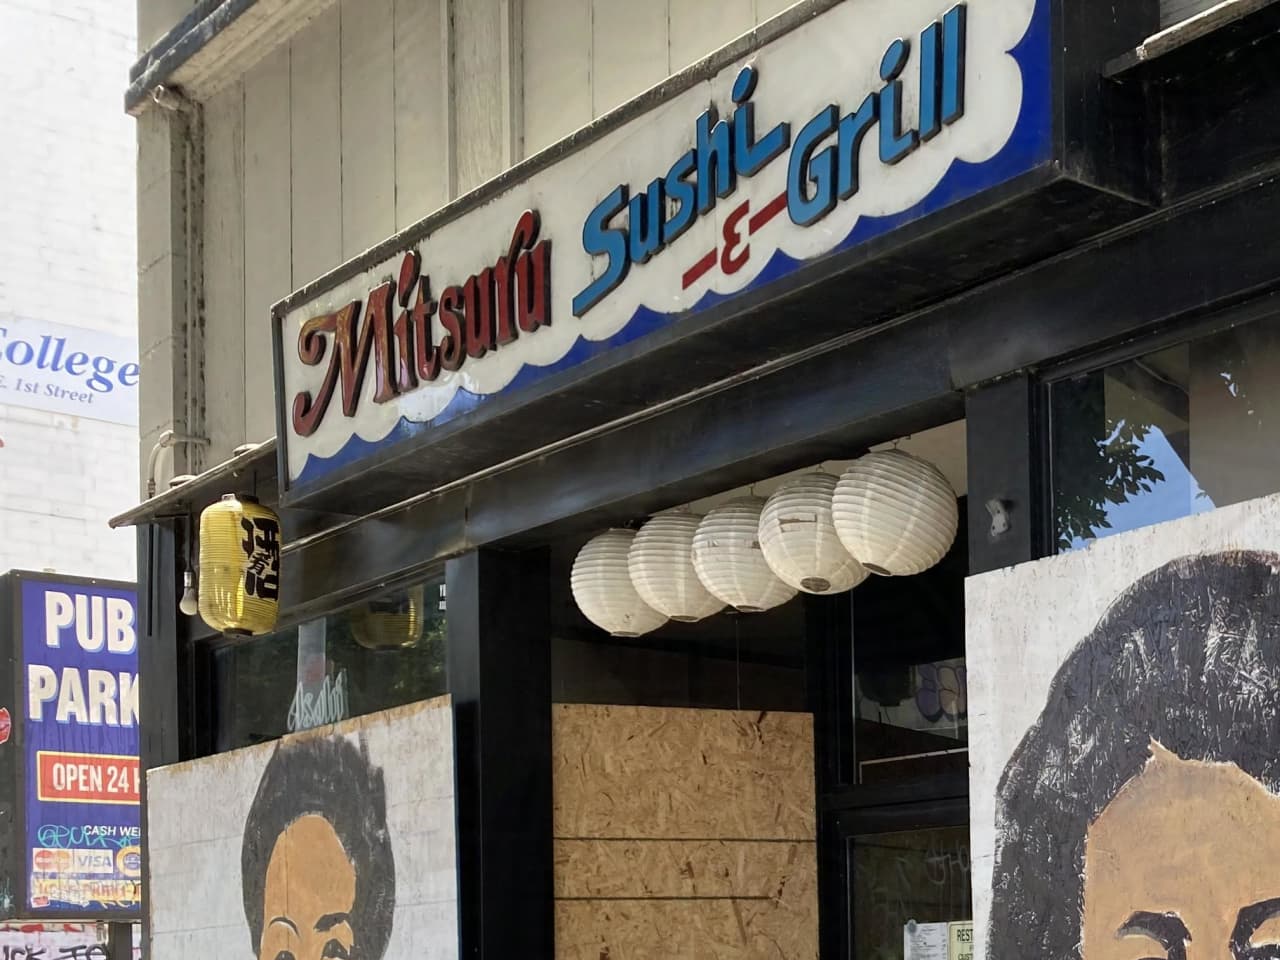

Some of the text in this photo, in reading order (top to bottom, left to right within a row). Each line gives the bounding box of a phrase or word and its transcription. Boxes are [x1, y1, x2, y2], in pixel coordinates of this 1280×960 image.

[292, 208, 551, 437] Mitsuru
[572, 64, 791, 317] Sushi
[786, 2, 967, 227] Grill
[15, 378, 40, 395] 1st
[43, 383, 95, 405] Street
[52, 762, 103, 793] OPEN
[107, 765, 130, 794] 24
[83, 825, 117, 837] CASH
[119, 827, 141, 838] WE
[77, 855, 113, 868] VISA
